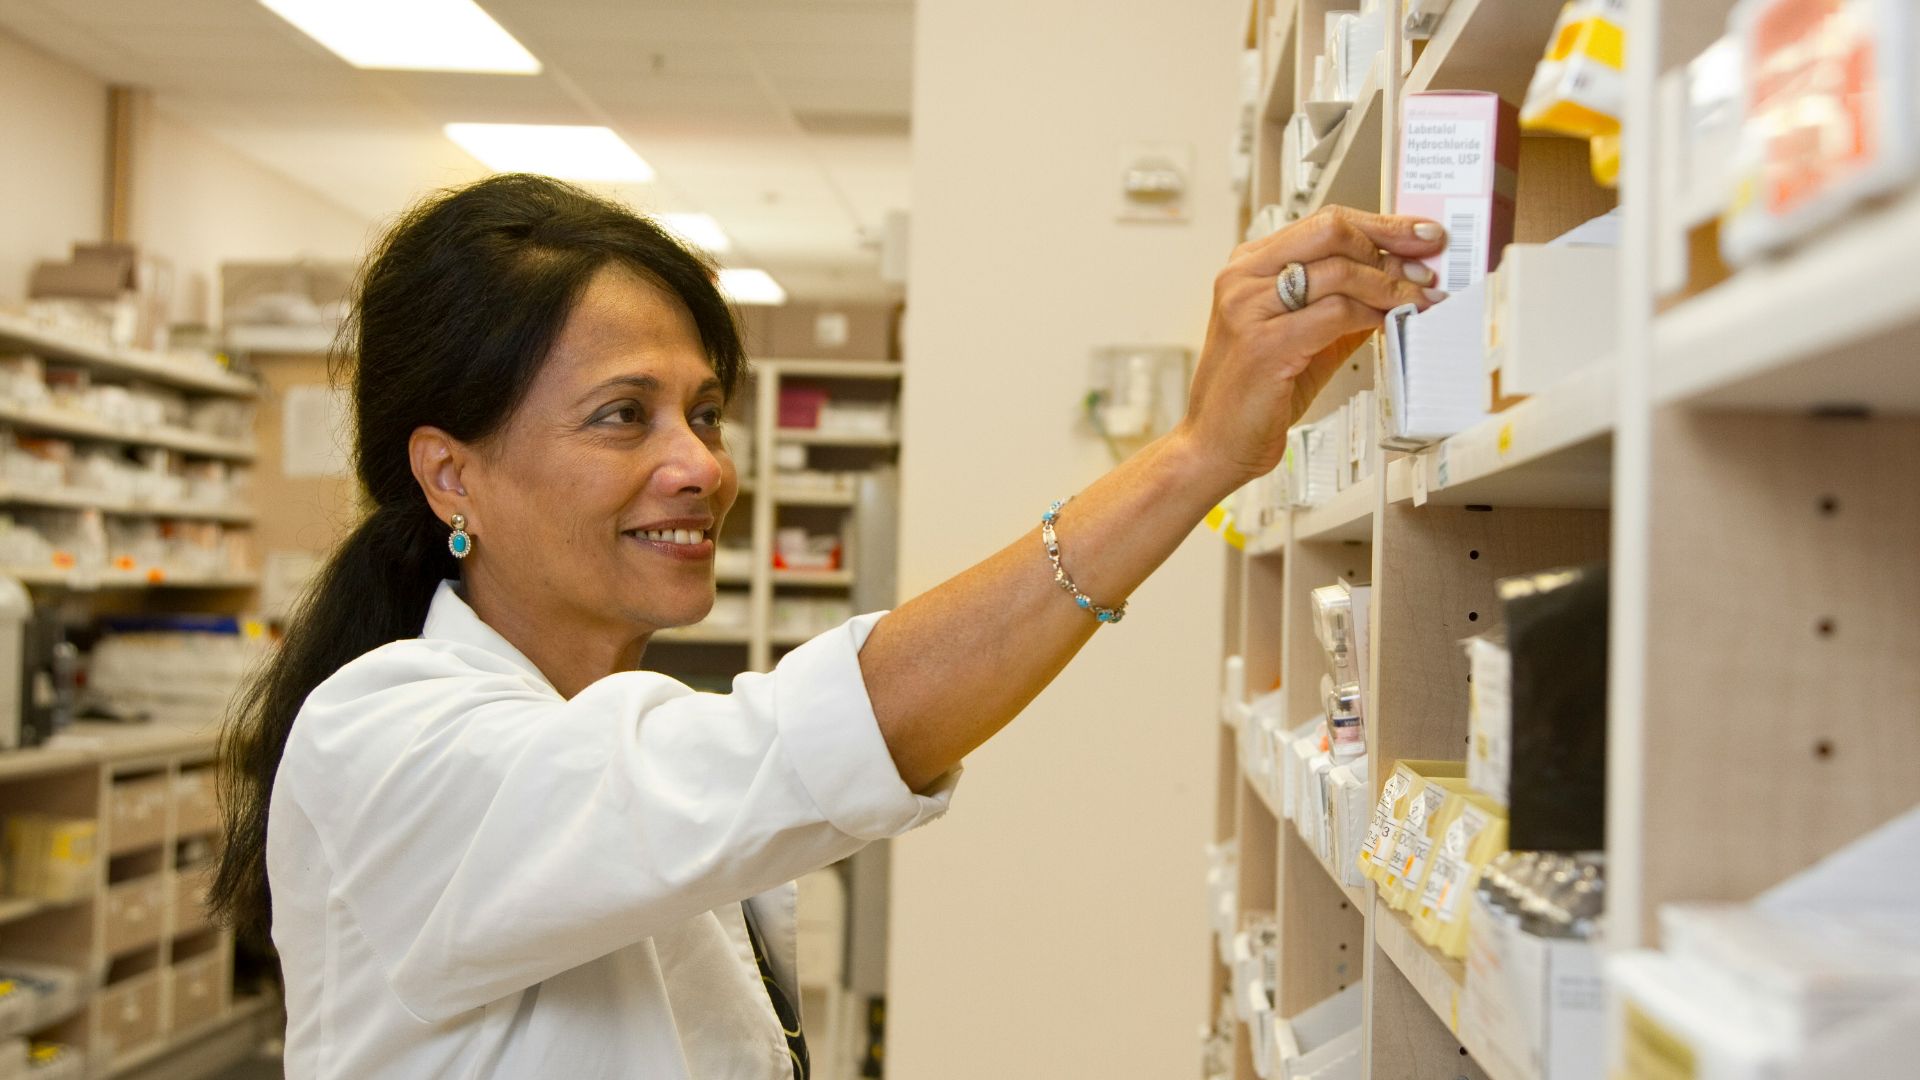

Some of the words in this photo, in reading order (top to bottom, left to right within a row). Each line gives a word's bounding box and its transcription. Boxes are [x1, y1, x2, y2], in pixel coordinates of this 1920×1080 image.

[1408, 123, 1456, 135] Labetalol
[1407, 138, 1481, 151] Hydrochloride
[1406, 153, 1456, 166] Injection,
[1458, 153, 1481, 165] USP
